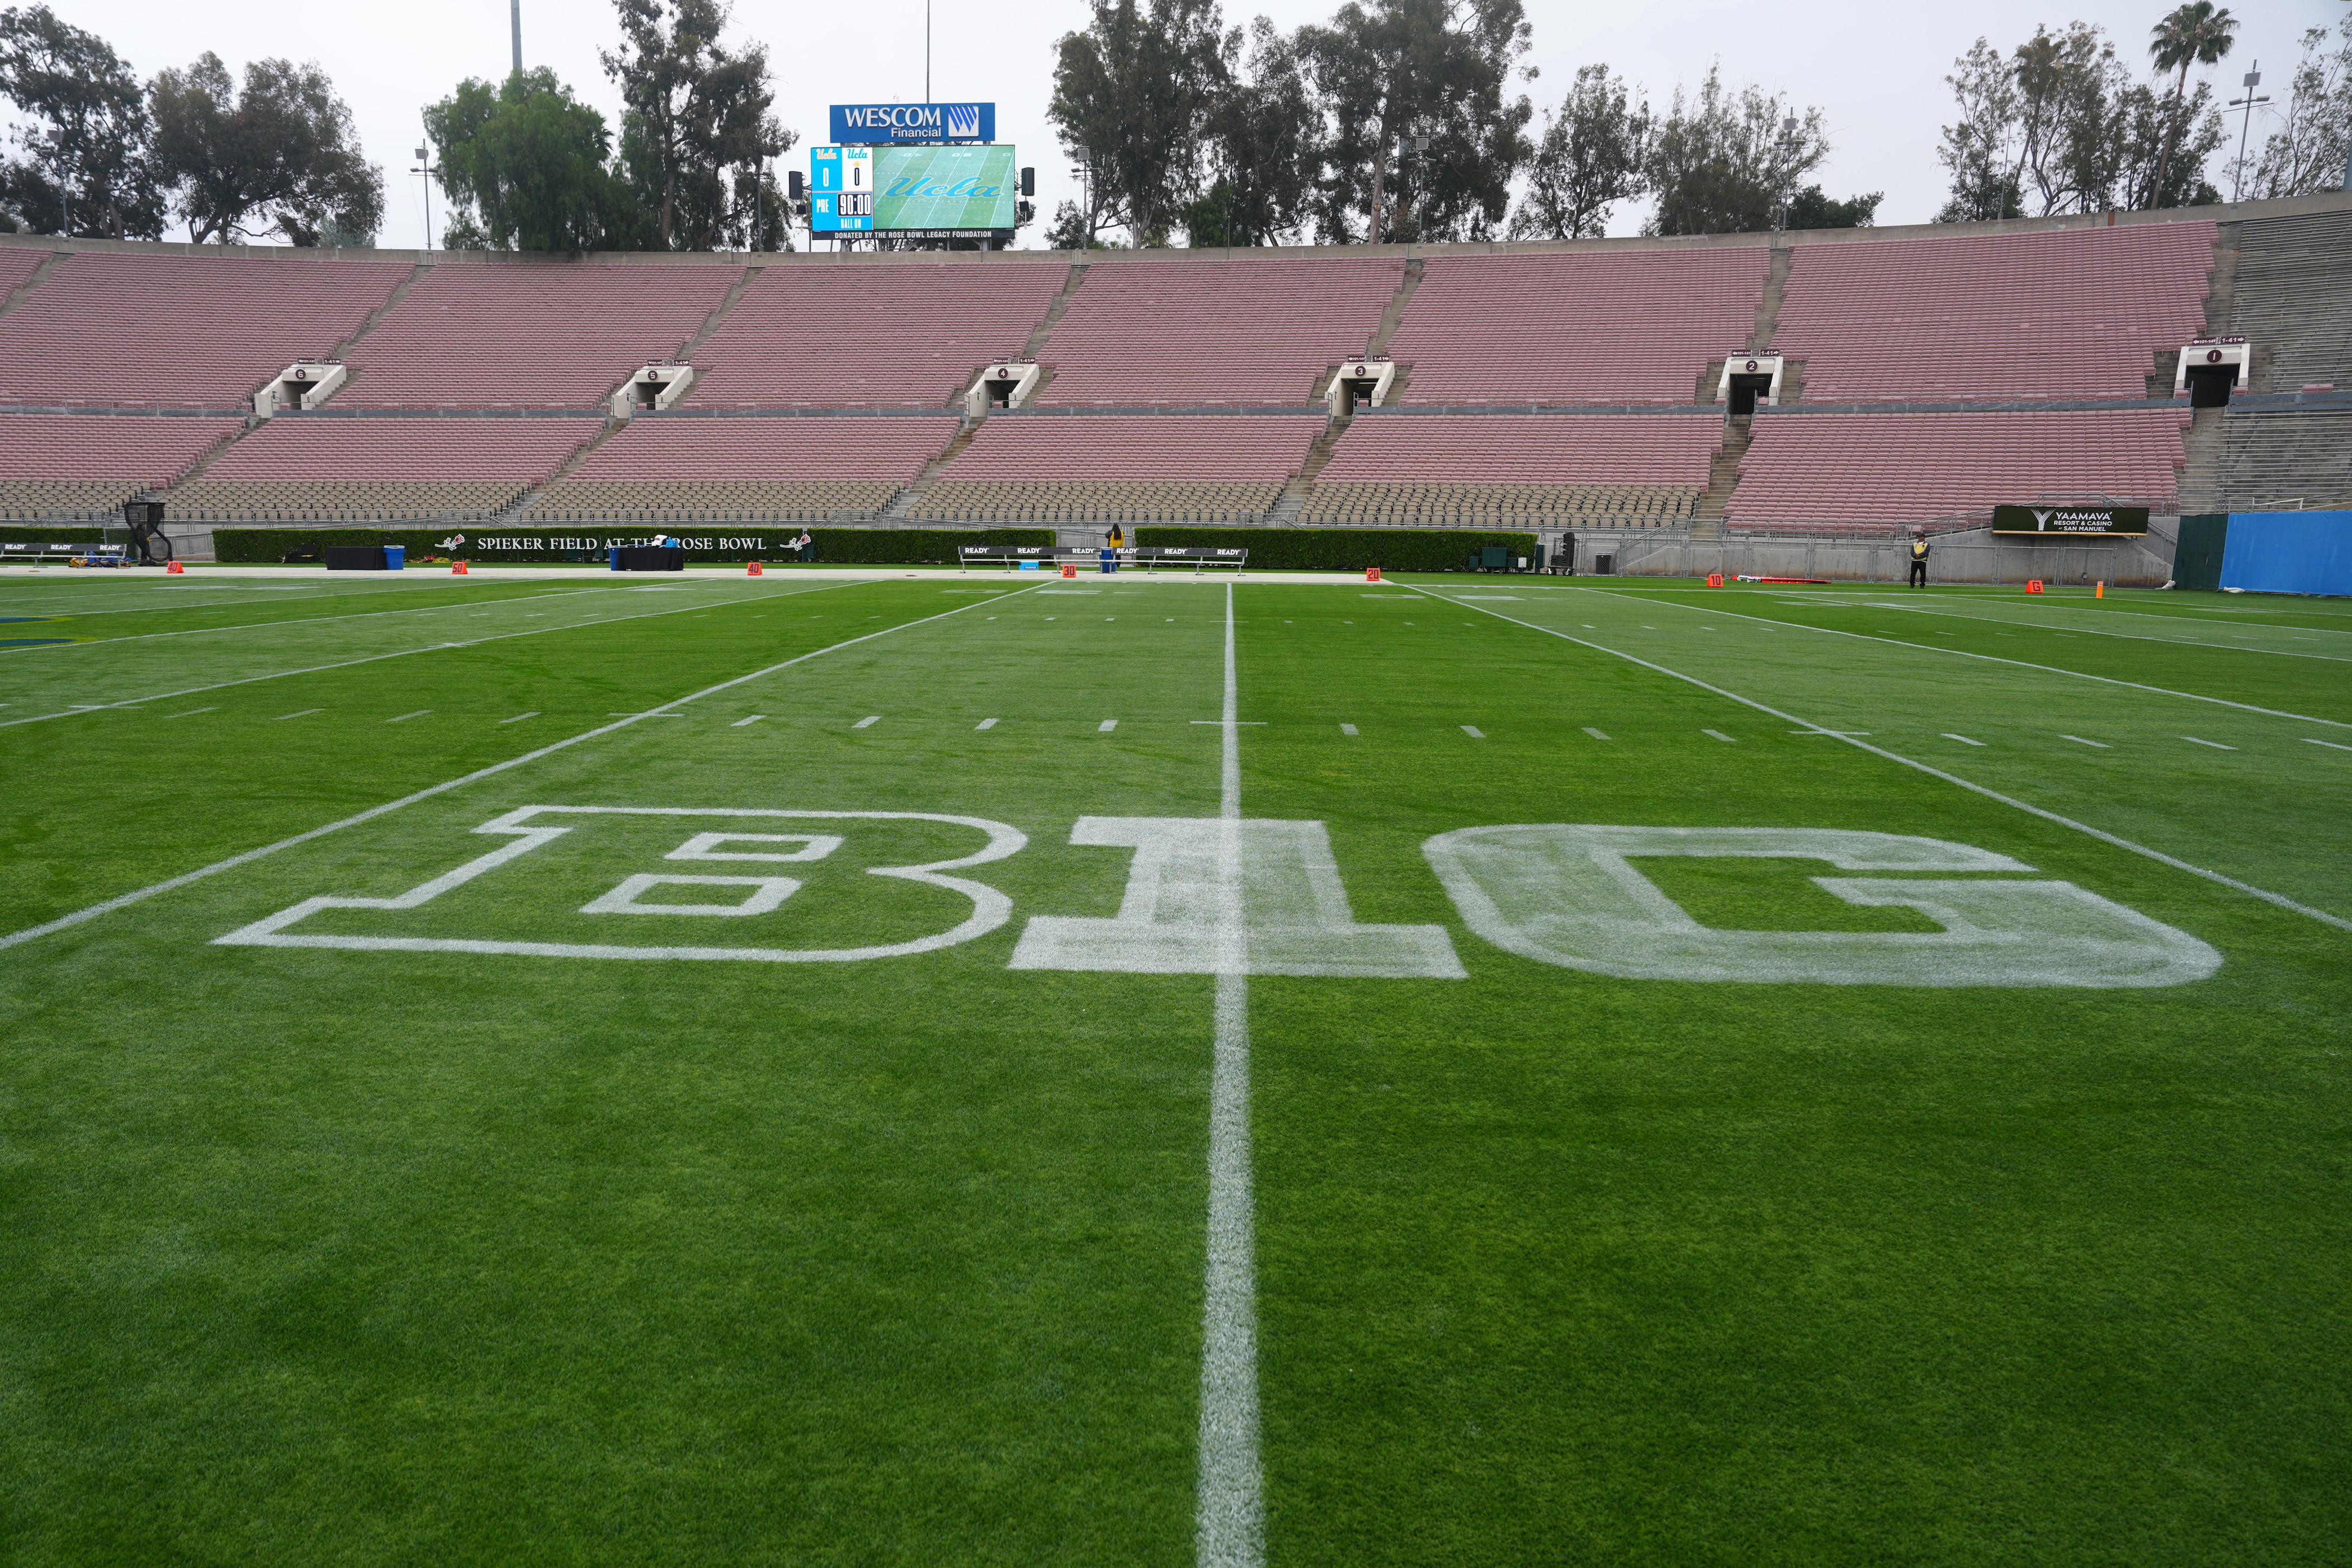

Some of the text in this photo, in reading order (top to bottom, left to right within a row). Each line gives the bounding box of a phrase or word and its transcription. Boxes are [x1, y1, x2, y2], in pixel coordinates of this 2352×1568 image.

[844, 107, 941, 127] WESCOM
[891, 127, 941, 138] Financial
[823, 167, 829, 187] 0
[854, 167, 860, 186] 0
[816, 199, 829, 213] PRE
[840, 194, 871, 215] 90:00
[840, 219, 862, 228] BALL ON
[478, 538, 544, 550] SPIEKER
[550, 538, 598, 550] FIELD
[719, 538, 767, 550] BOWL
[168, 562, 178, 572] 40
[452, 563, 463, 573] 50
[748, 563, 759, 573] 40
[1064, 566, 1075, 576] 30
[1368, 569, 1379, 579] 20
[1712, 575, 1721, 585] 10
[2033, 582, 2041, 592] G
